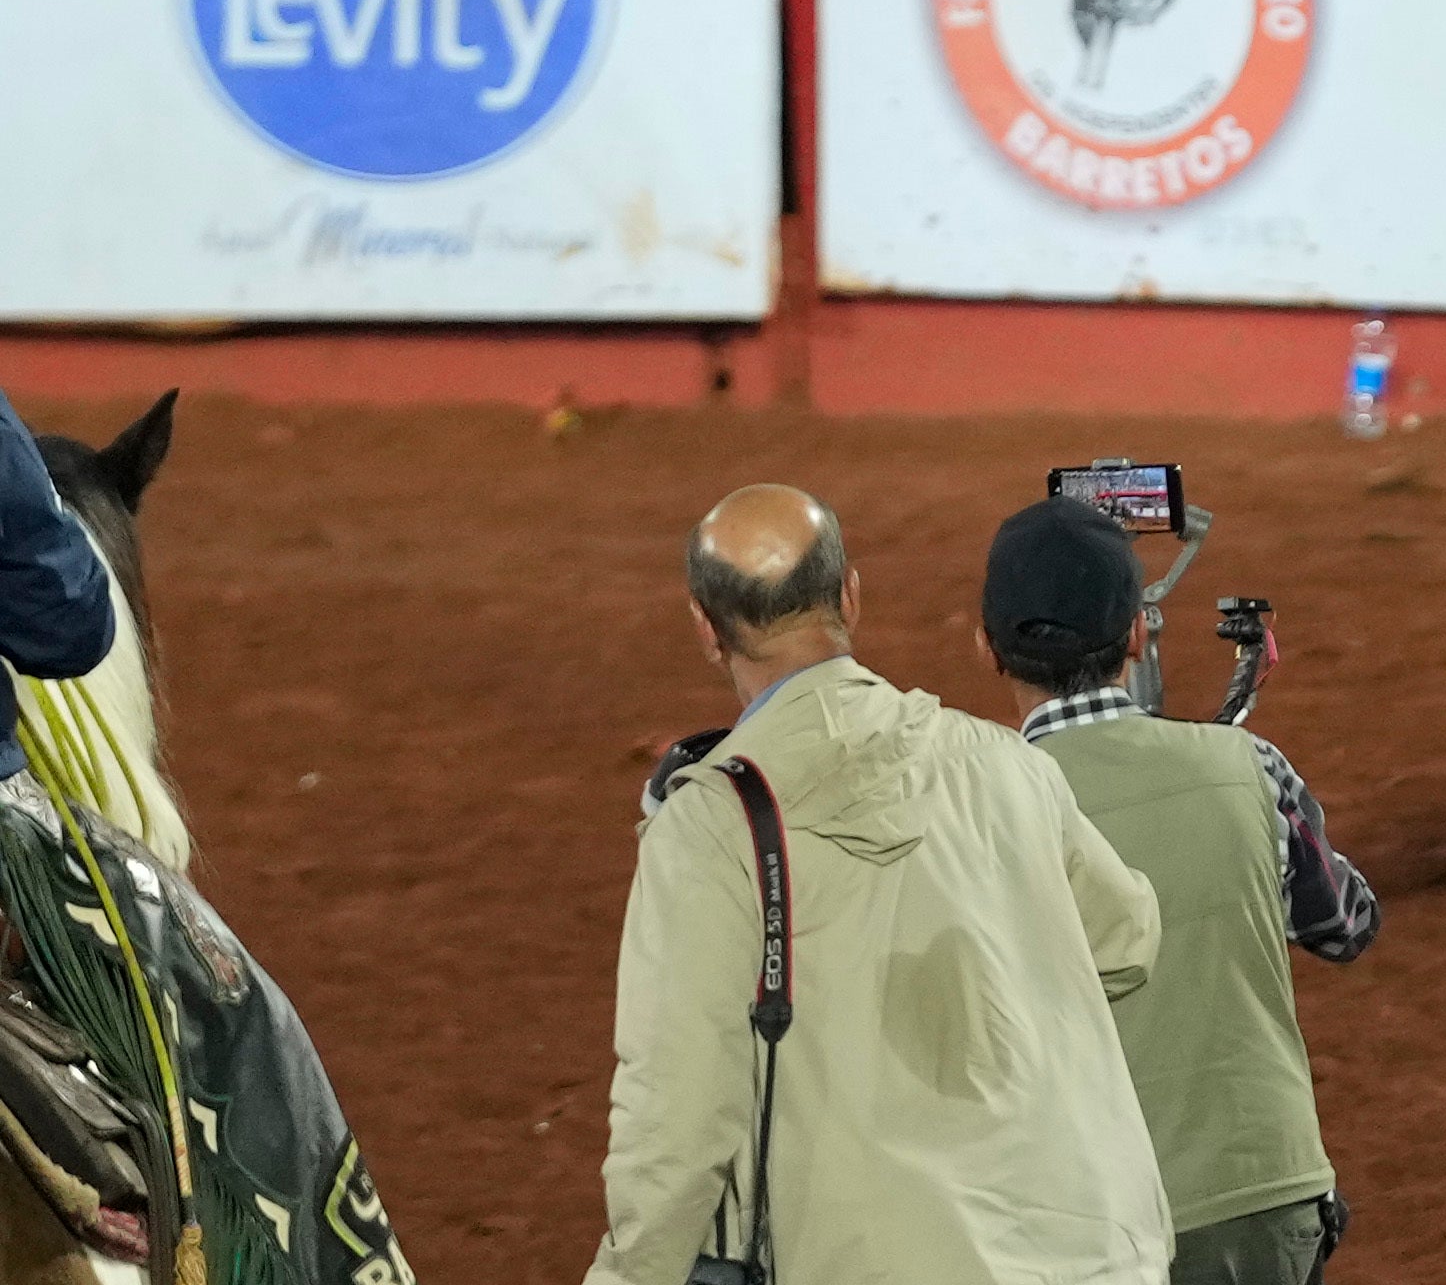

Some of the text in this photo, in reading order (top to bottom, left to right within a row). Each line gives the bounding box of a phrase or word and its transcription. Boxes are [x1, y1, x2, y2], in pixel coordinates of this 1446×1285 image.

[1005, 112, 1256, 205] BARRETOS
[766, 906, 783, 934] 5D
[764, 937, 783, 991] EOS
